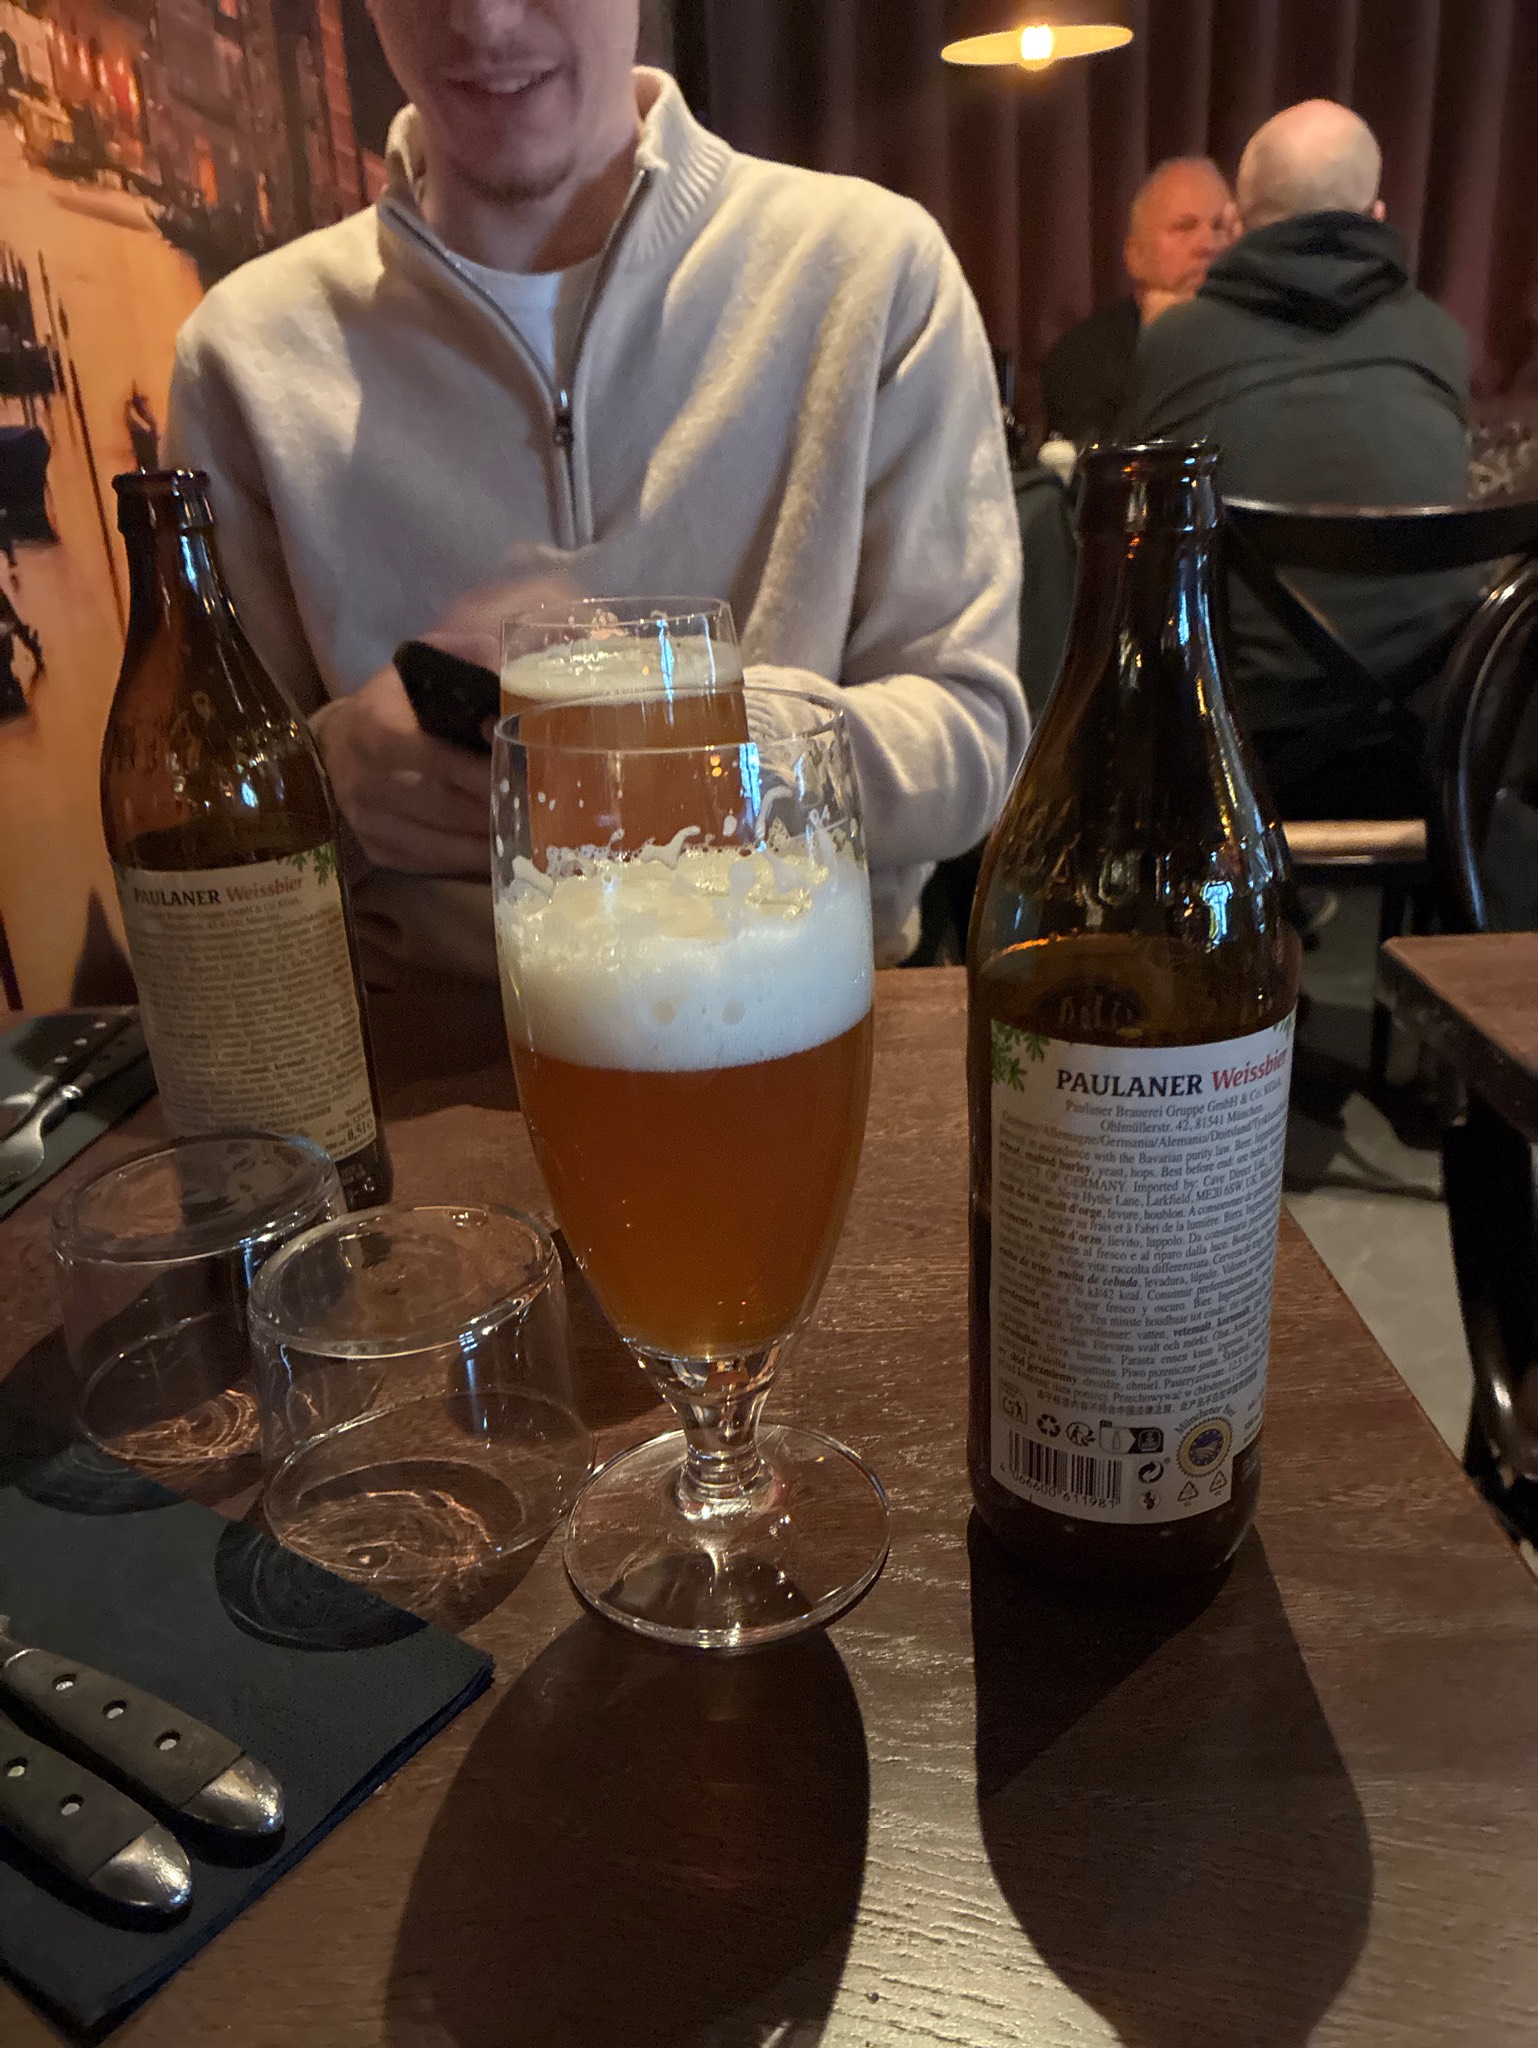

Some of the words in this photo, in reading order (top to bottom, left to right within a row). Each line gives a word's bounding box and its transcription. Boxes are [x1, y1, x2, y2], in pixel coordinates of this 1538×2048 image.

[133, 888, 221, 906] PAULANER
[225, 876, 302, 903] Weissbier
[1057, 1070, 1202, 1097] PAULANER
[1211, 1047, 1288, 1092] Weissbier
[1066, 1099, 1112, 1115] Paulaner
[1116, 1106, 1162, 1117] Brauerei
[1165, 1105, 1204, 1118] Gruppe
[1207, 1096, 1238, 1111] GmbH
[1240, 1093, 1247, 1104] &
[1100, 1120, 1172, 1132] Ohlmüllerstr.
[1175, 1119, 1192, 1131] 42,
[1194, 1115, 1223, 1129] 81541
[1094, 1152, 1116, 1162] with
[1119, 1152, 1135, 1163] the
[1138, 1152, 1182, 1163] Bavarian
[1185, 1149, 1212, 1163] purity
[1097, 1168, 1127, 1179] yeast,
[1160, 1166, 1182, 1177] Best
[1185, 1163, 1214, 1175] before
[1133, 1180, 1178, 1195] Imported
[1203, 1175, 1224, 1186] Cave
[1082, 1191, 1112, 1205] Hythe
[1115, 1194, 1143, 1206] Lane,
[1196, 1186, 1222, 1200] ME20
[1068, 1203, 1105, 1220] d'orge,
[1107, 1208, 1141, 1220] levure,
[1144, 1209, 1183, 1219] houblon.
[1190, 1206, 1195, 1216] A
[1197, 1196, 1243, 1214] consommer
[1114, 1224, 1122, 1233] et
[1126, 1222, 1132, 1233] à
[1161, 1222, 1173, 1232] de
[1175, 1220, 1184, 1231] la
[1039, 1224, 1065, 1238] malto
[1108, 1235, 1143, 1248] lievito,
[1146, 1236, 1184, 1249] luppolo.
[1188, 1232, 1201, 1243] Da
[1083, 1247, 1092, 1256] al
[1096, 1248, 1127, 1260] fresco
[1130, 1252, 1136, 1261] e
[1140, 1250, 1149, 1261] al
[1153, 1251, 1182, 1264] riparo
[1185, 1244, 1207, 1257] dalla
[1111, 1263, 1149, 1274] raccolta
[1087, 1273, 1099, 1284] de
[1102, 1276, 1141, 1287] cebada,
[1144, 1276, 1188, 1287] levadura,
[1118, 1290, 1141, 1301] kcal.
[1146, 1288, 1192, 1300] Consumir
[1105, 1301, 1135, 1313] fresco
[1141, 1306, 1148, 1317] y
[1110, 1318, 1141, 1326] minste
[1190, 1311, 1201, 1321] tot
[1138, 1342, 1160, 1351] svalt
[1163, 1340, 1180, 1350] och
[1121, 1354, 1155, 1365] Parasta
[1160, 1353, 1187, 1364] ennen
[1117, 1367, 1146, 1377] Piwo
[1148, 1365, 1196, 1380] pszeniczne
[1126, 1379, 1160, 1390] chmiel.
[1113, 1391, 1181, 1405] Przechowywać
[1174, 1405, 1221, 1434] Münchener
[1062, 1491, 1115, 1510] 611981
